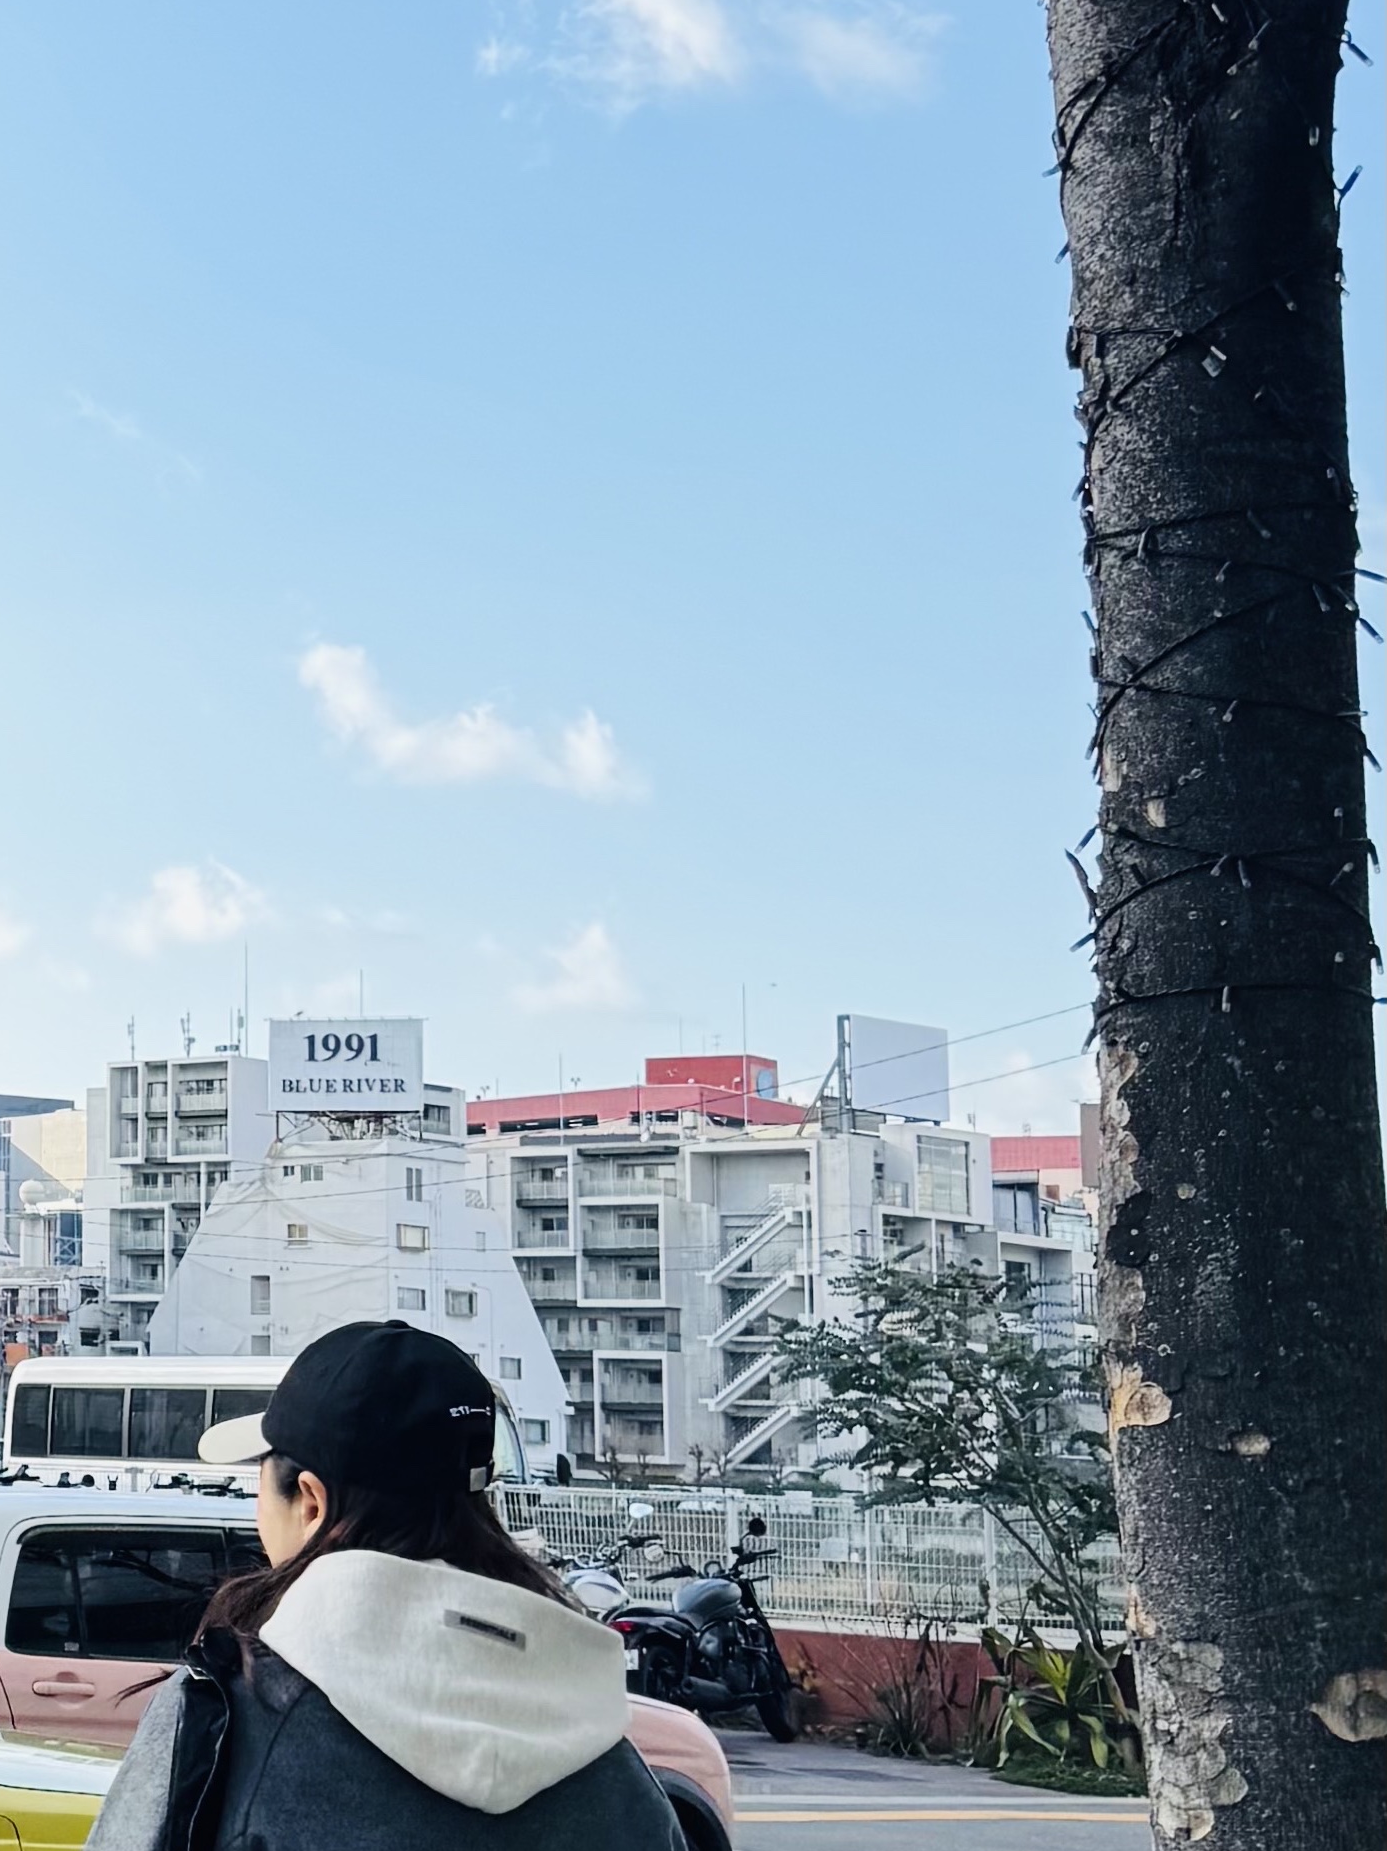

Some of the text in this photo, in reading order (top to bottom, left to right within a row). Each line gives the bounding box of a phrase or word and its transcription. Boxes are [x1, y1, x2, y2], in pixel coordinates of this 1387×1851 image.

[303, 1033, 381, 1062] 1991
[282, 1078, 406, 1093] BLUE RIVER
